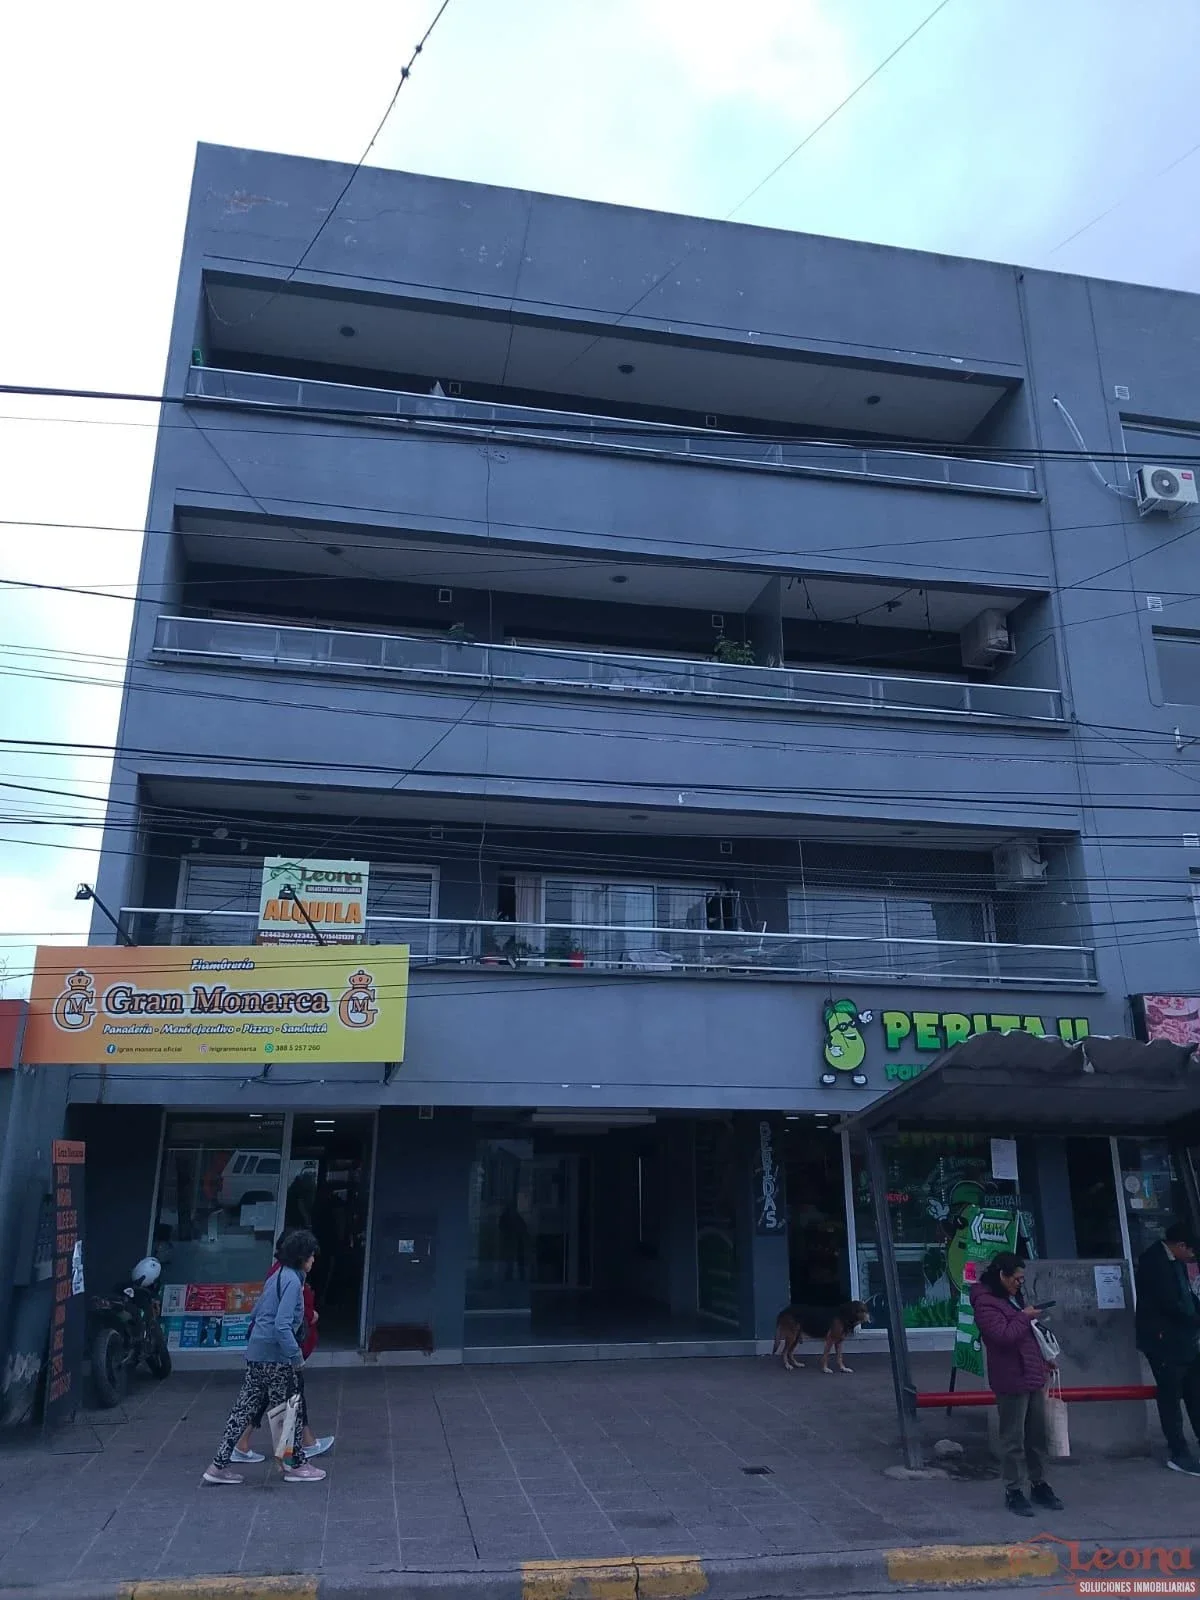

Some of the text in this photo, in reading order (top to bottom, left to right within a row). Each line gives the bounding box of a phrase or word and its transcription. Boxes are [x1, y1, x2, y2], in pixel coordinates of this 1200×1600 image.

[300, 867, 362, 885] Leona
[263, 899, 362, 924] ALQUILA
[105, 986, 329, 1014] Gran Monarca
[242, 1024, 274, 1035] Pizzas
